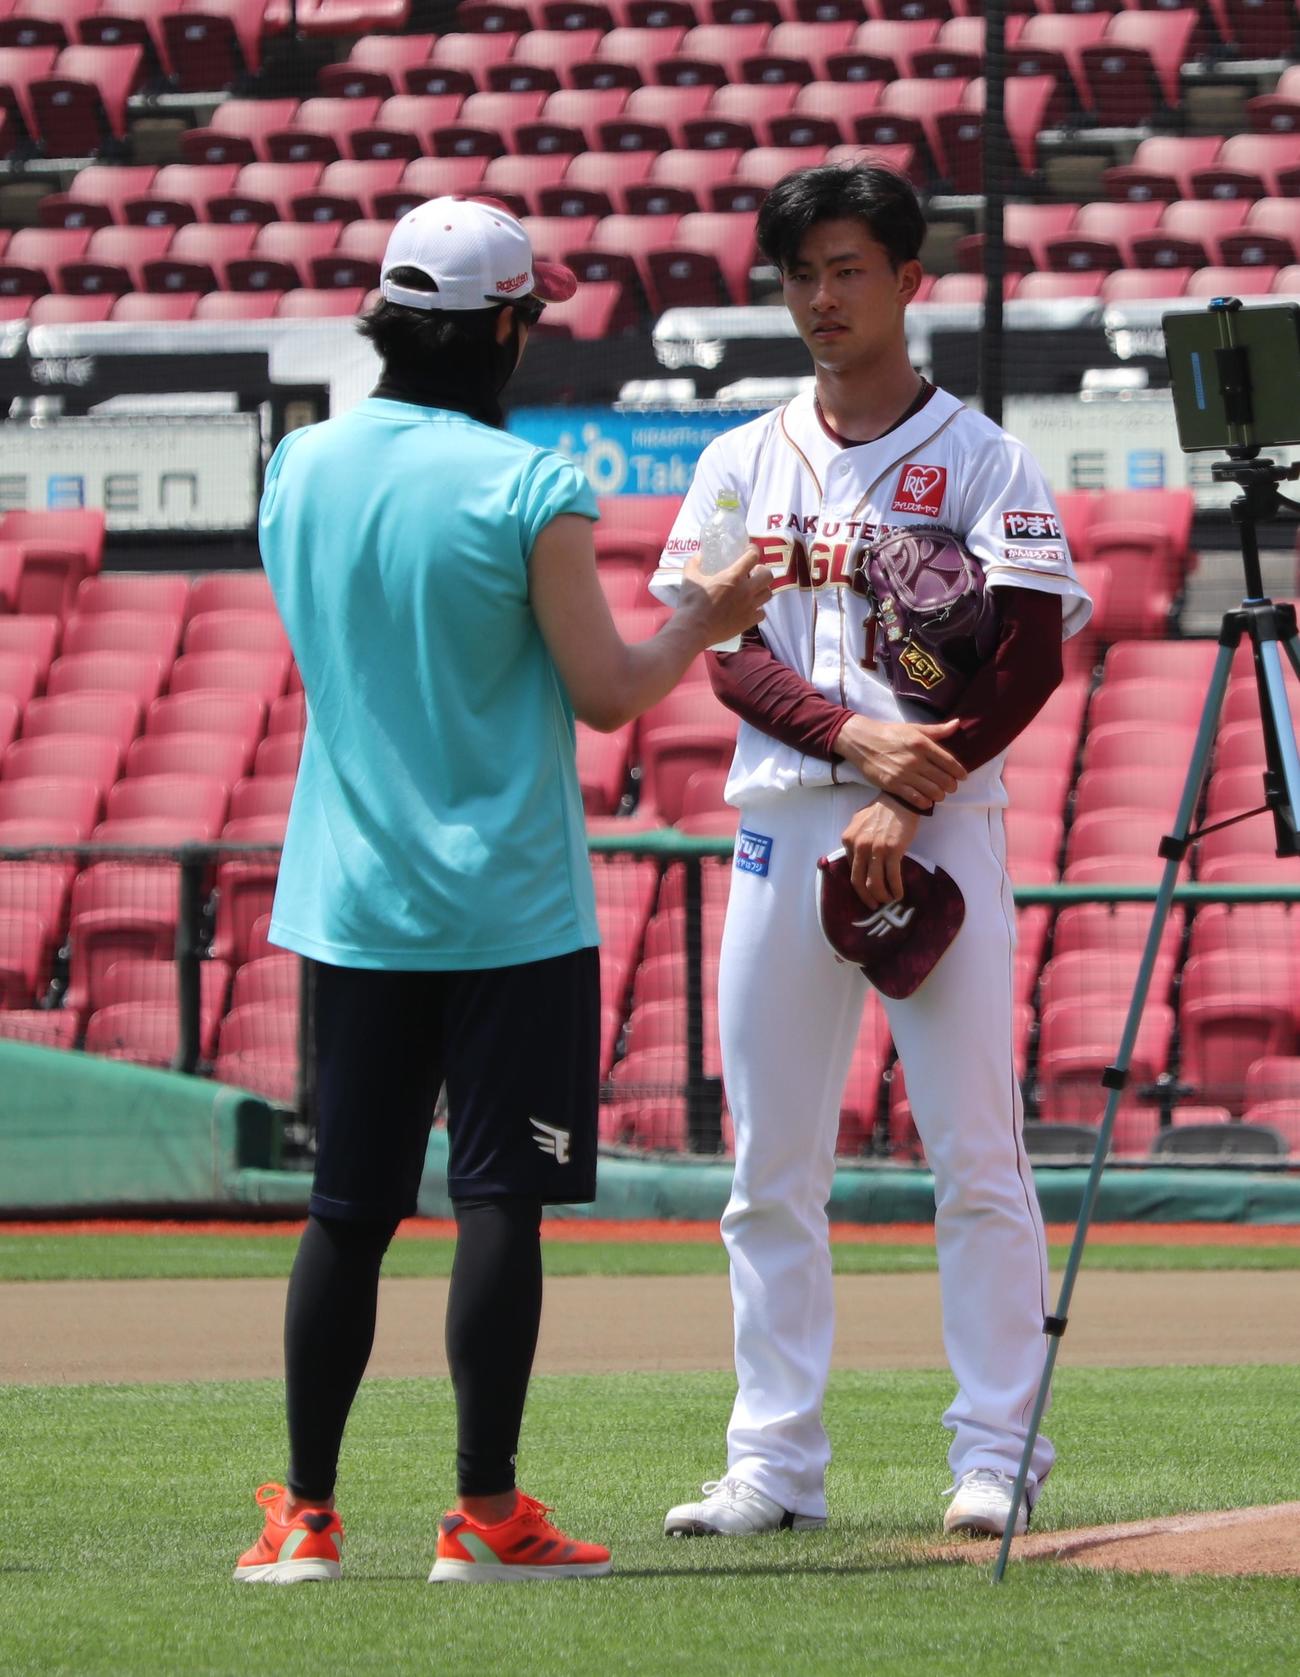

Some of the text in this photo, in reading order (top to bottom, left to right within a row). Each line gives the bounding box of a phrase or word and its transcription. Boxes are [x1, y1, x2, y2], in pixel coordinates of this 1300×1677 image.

[496, 272, 528, 292] Rakuten
[630, 454, 697, 493] Tak
[902, 474, 928, 494] IRIS
[892, 501, 939, 516] アイリスオーヤマ
[905, 649, 940, 682] ZETT
